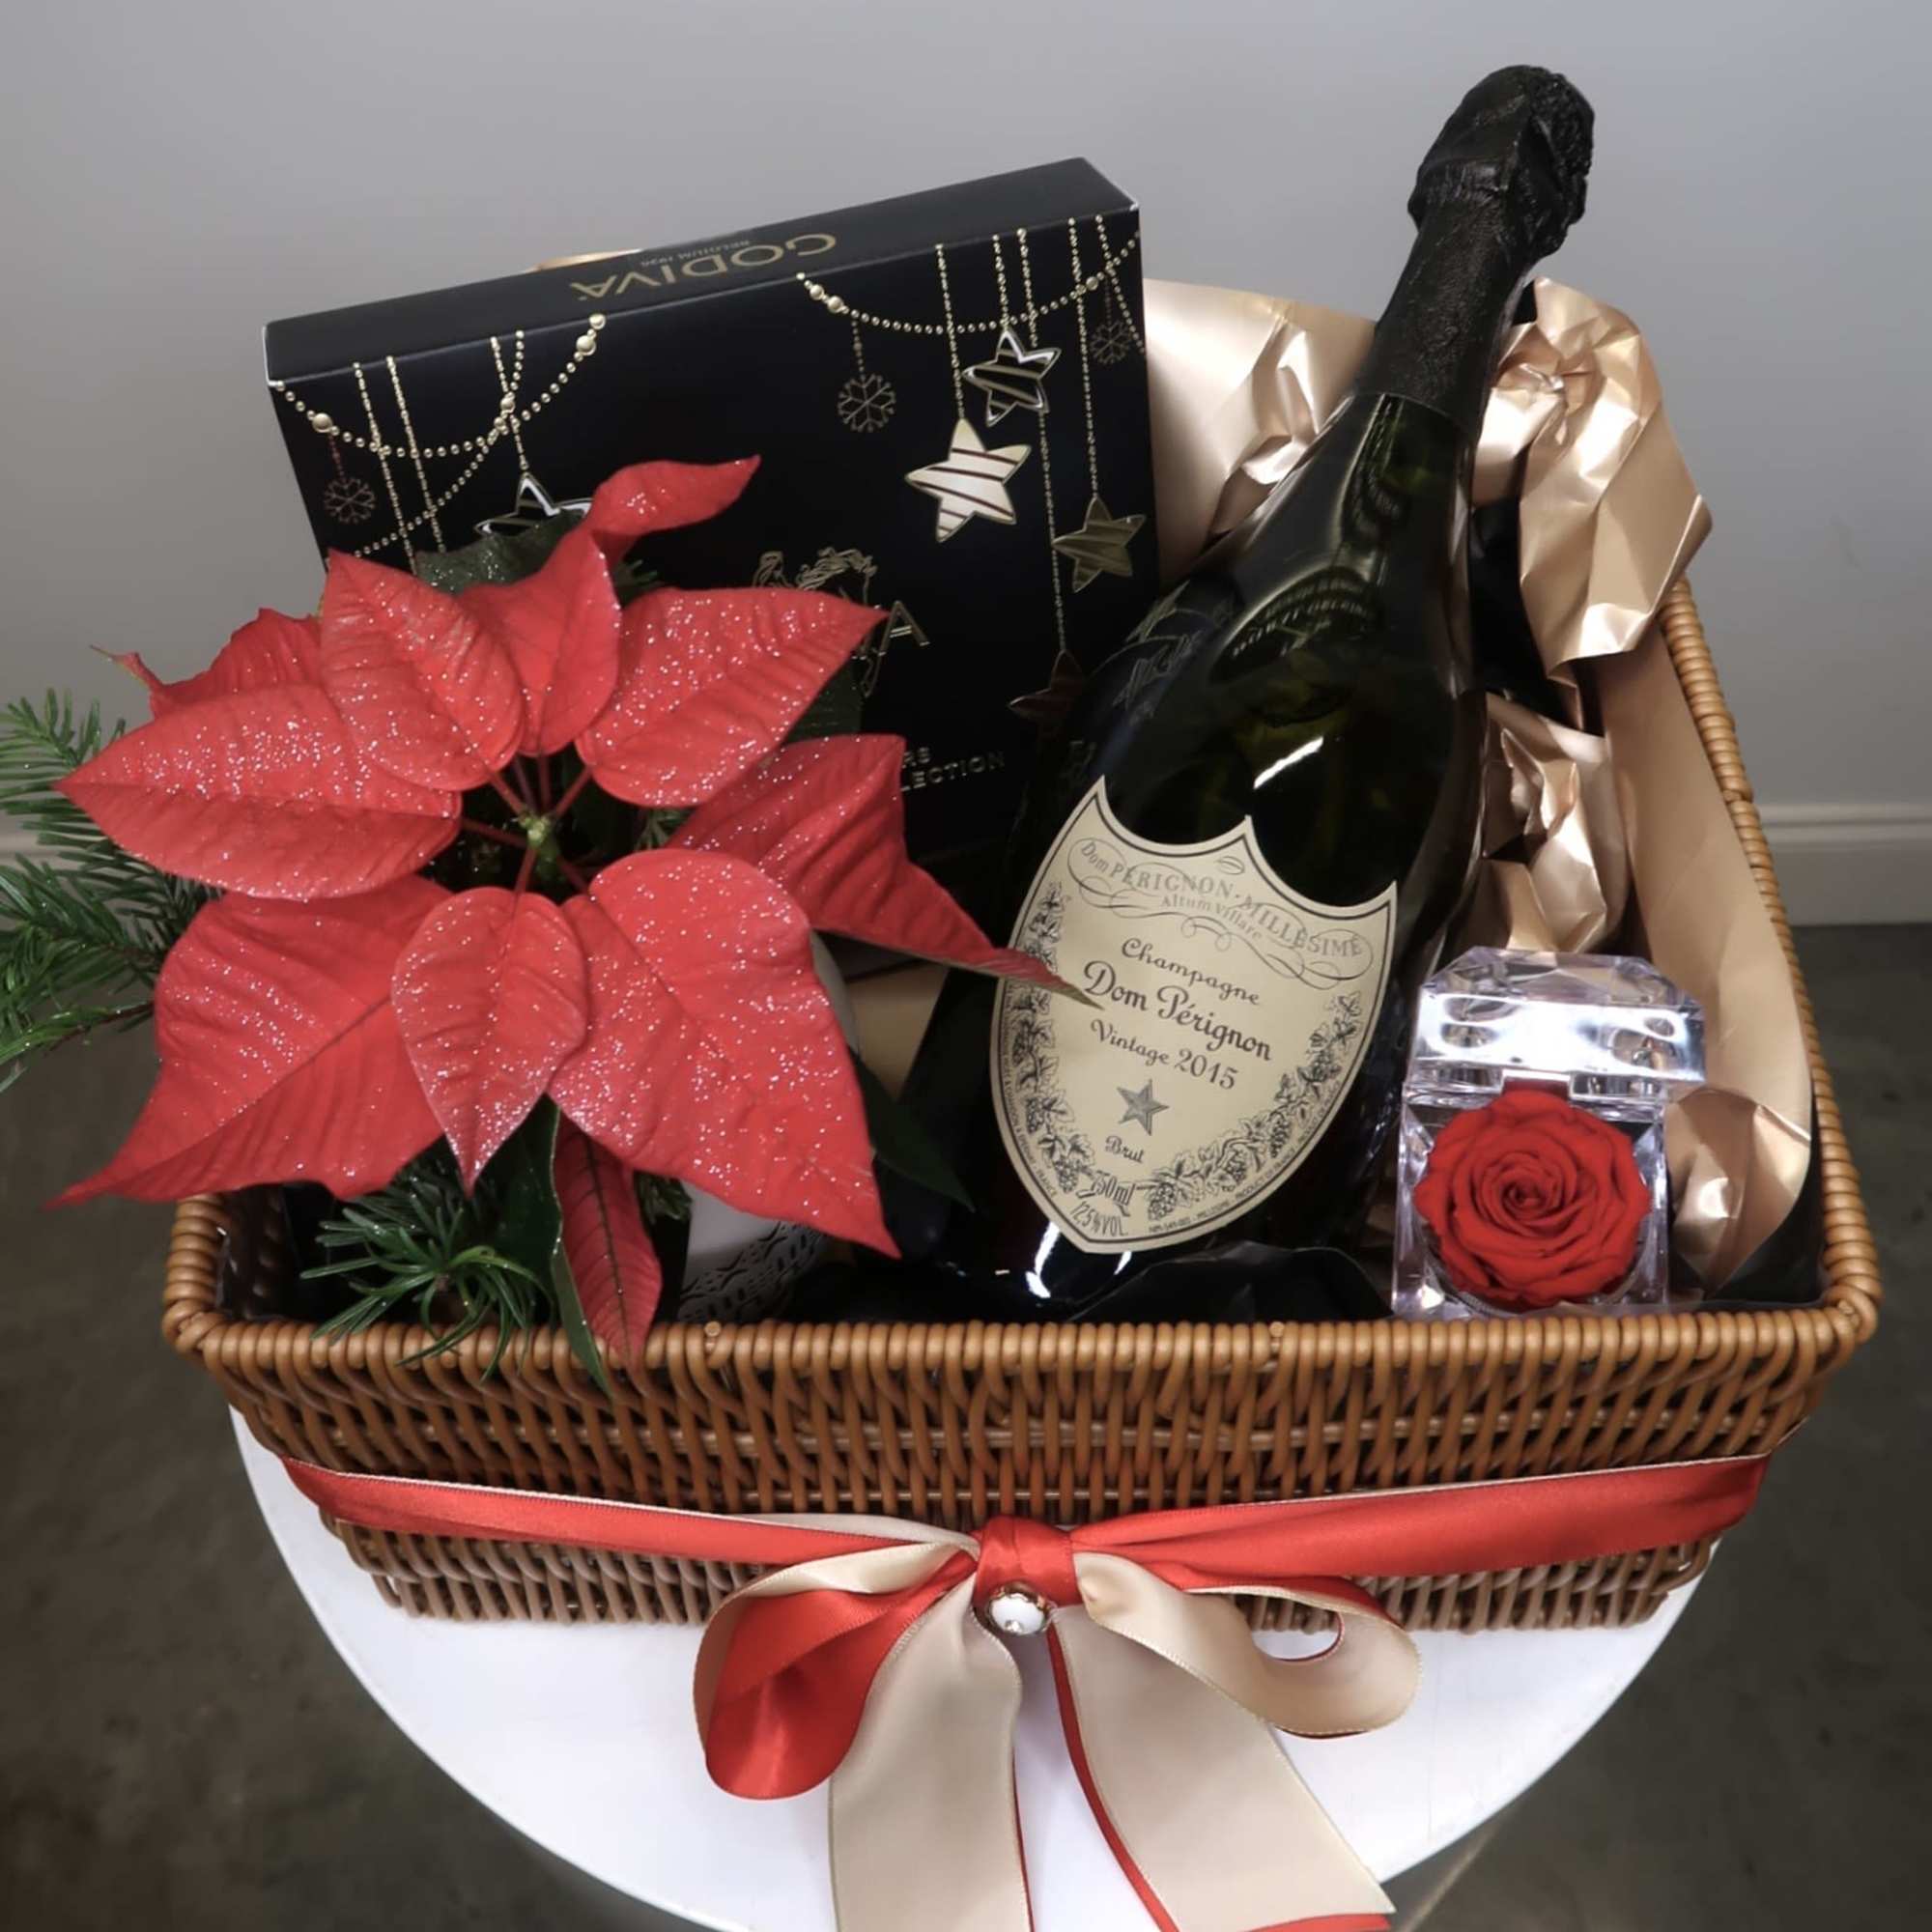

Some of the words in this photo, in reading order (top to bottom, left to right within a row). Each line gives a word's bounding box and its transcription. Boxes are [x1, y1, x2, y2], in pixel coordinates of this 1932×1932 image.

[570, 233, 838, 298] GODIVA
[1081, 840, 1110, 873] Dom
[1121, 937, 1261, 1006] Champagne
[1083, 959, 1148, 1011] Dom
[1156, 984, 1272, 1062] Pérignon
[1090, 1018, 1170, 1066] Vintage
[1174, 1047, 1239, 1090] 2015
[1104, 1134, 1144, 1164] Brut
